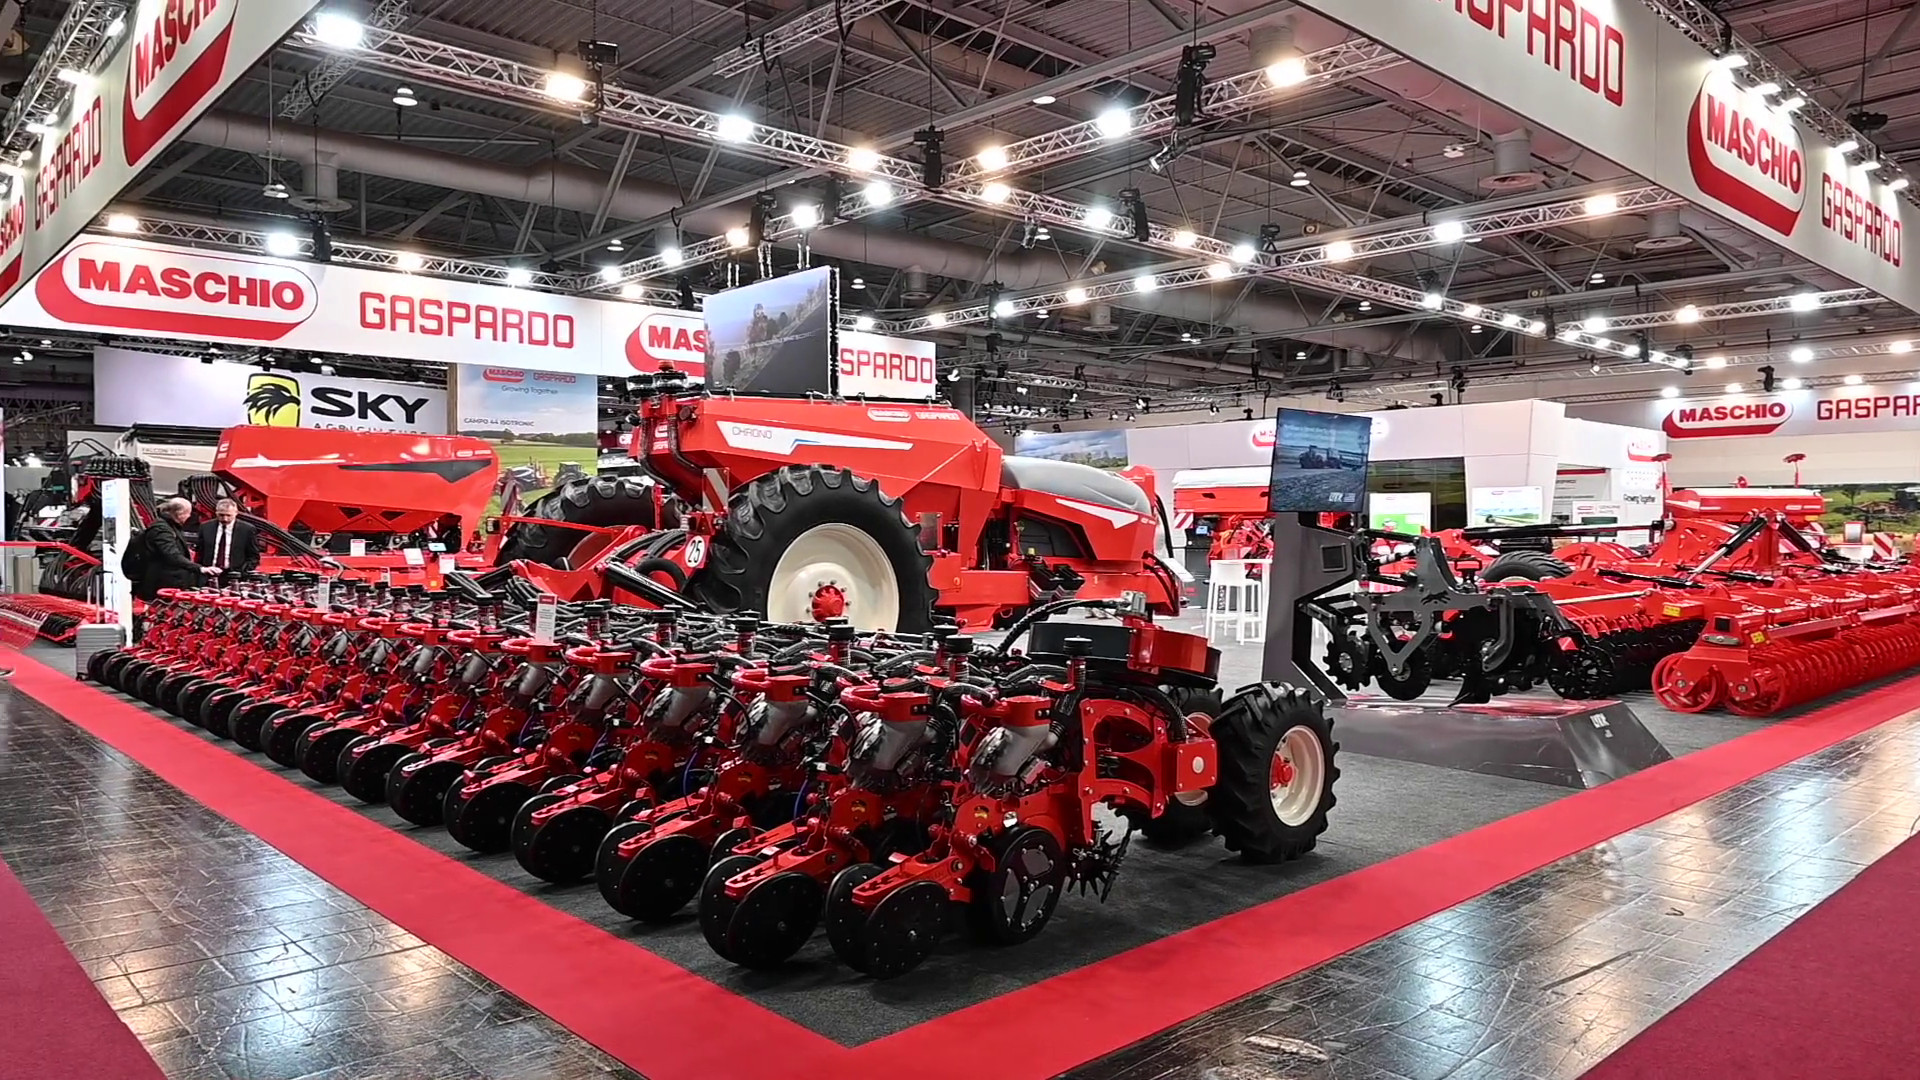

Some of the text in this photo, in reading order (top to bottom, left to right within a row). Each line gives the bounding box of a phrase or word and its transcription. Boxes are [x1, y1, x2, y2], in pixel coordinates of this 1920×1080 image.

[35, 95, 101, 231] GASPARDO
[1707, 93, 1903, 268] MASCHIO GASPARDO
[78, 257, 575, 349] MASCHIO GASPARDO
[310, 386, 430, 424] SKY
[1678, 402, 1786, 424] MASCHIO
[731, 426, 773, 440] CHRONO
[687, 539, 702, 563] 25
